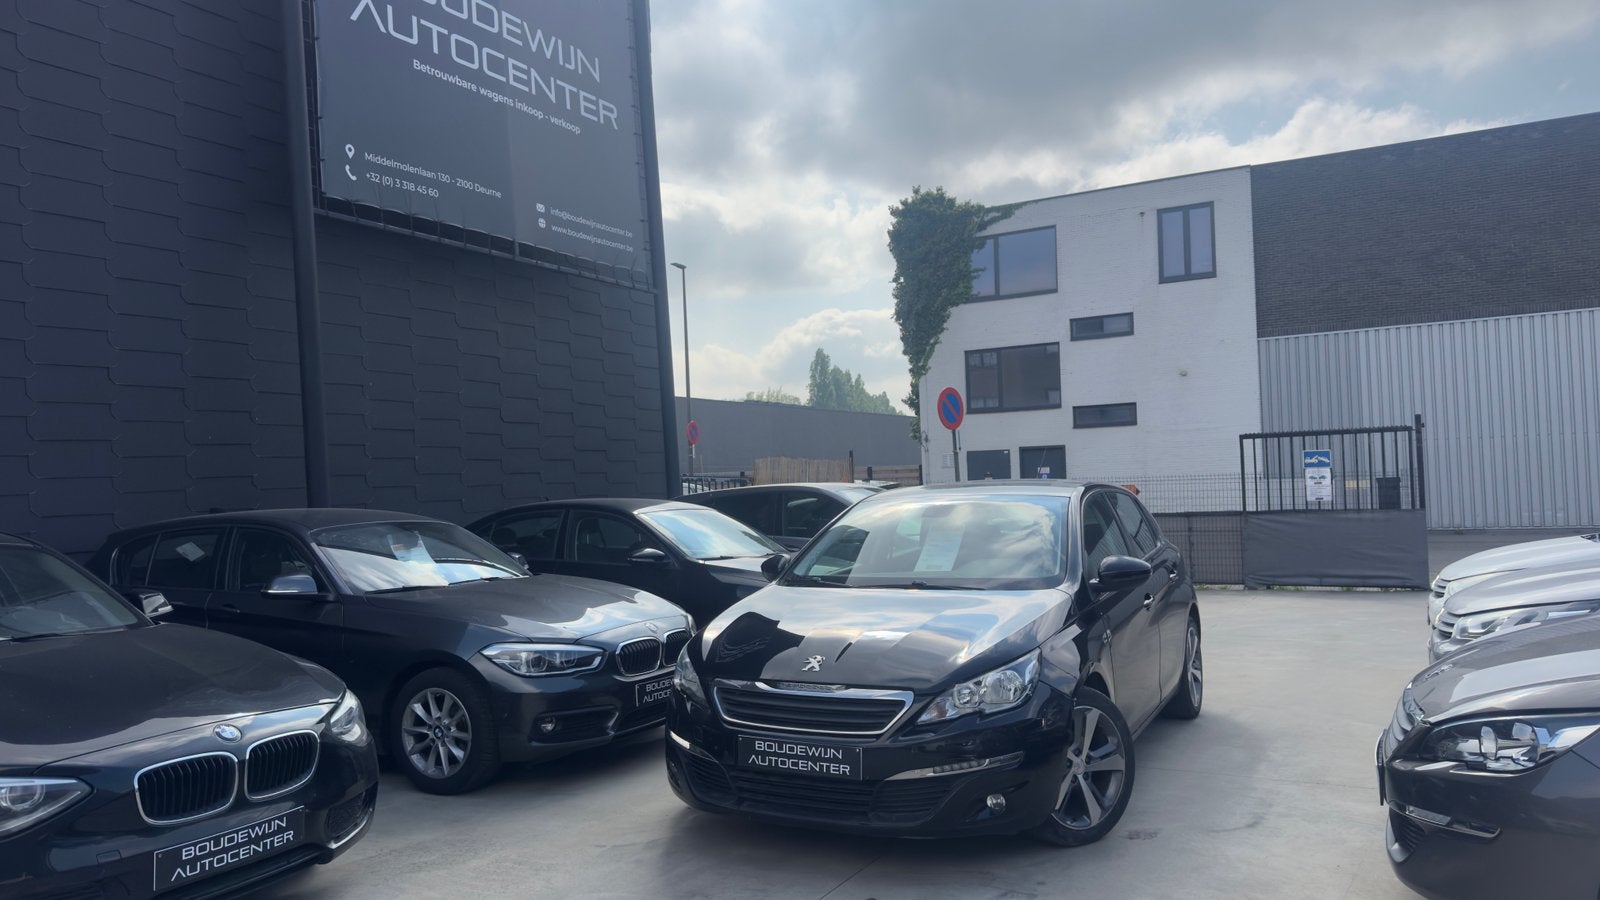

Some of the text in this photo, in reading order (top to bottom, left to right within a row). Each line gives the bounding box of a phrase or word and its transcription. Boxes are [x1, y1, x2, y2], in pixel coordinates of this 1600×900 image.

[349, 0, 619, 130] AUTOCENTER
[412, 59, 478, 93] Betrouwbare
[478, 86, 515, 108] wagens
[515, 98, 544, 120] inkoop
[549, 114, 582, 135] verkoop
[365, 152, 437, 179] Middelmolenlaan
[437, 172, 451, 184] 130
[456, 178, 474, 191] 2100
[474, 183, 502, 199] Deurne
[366, 171, 440, 199] +32 (0) 3 318 45 60
[550, 206, 633, 238] info@boudewijnautocenter.be
[551, 223, 634, 252] www.boudewijnautocenter.be
[646, 678, 674, 693] BOUDE
[748, 754, 850, 776] AUTOCENTER
[755, 740, 843, 760] BOUDEWIJN
[182, 816, 287, 860] BOUDEWIJN
[171, 830, 294, 881] AUTOCENTER
